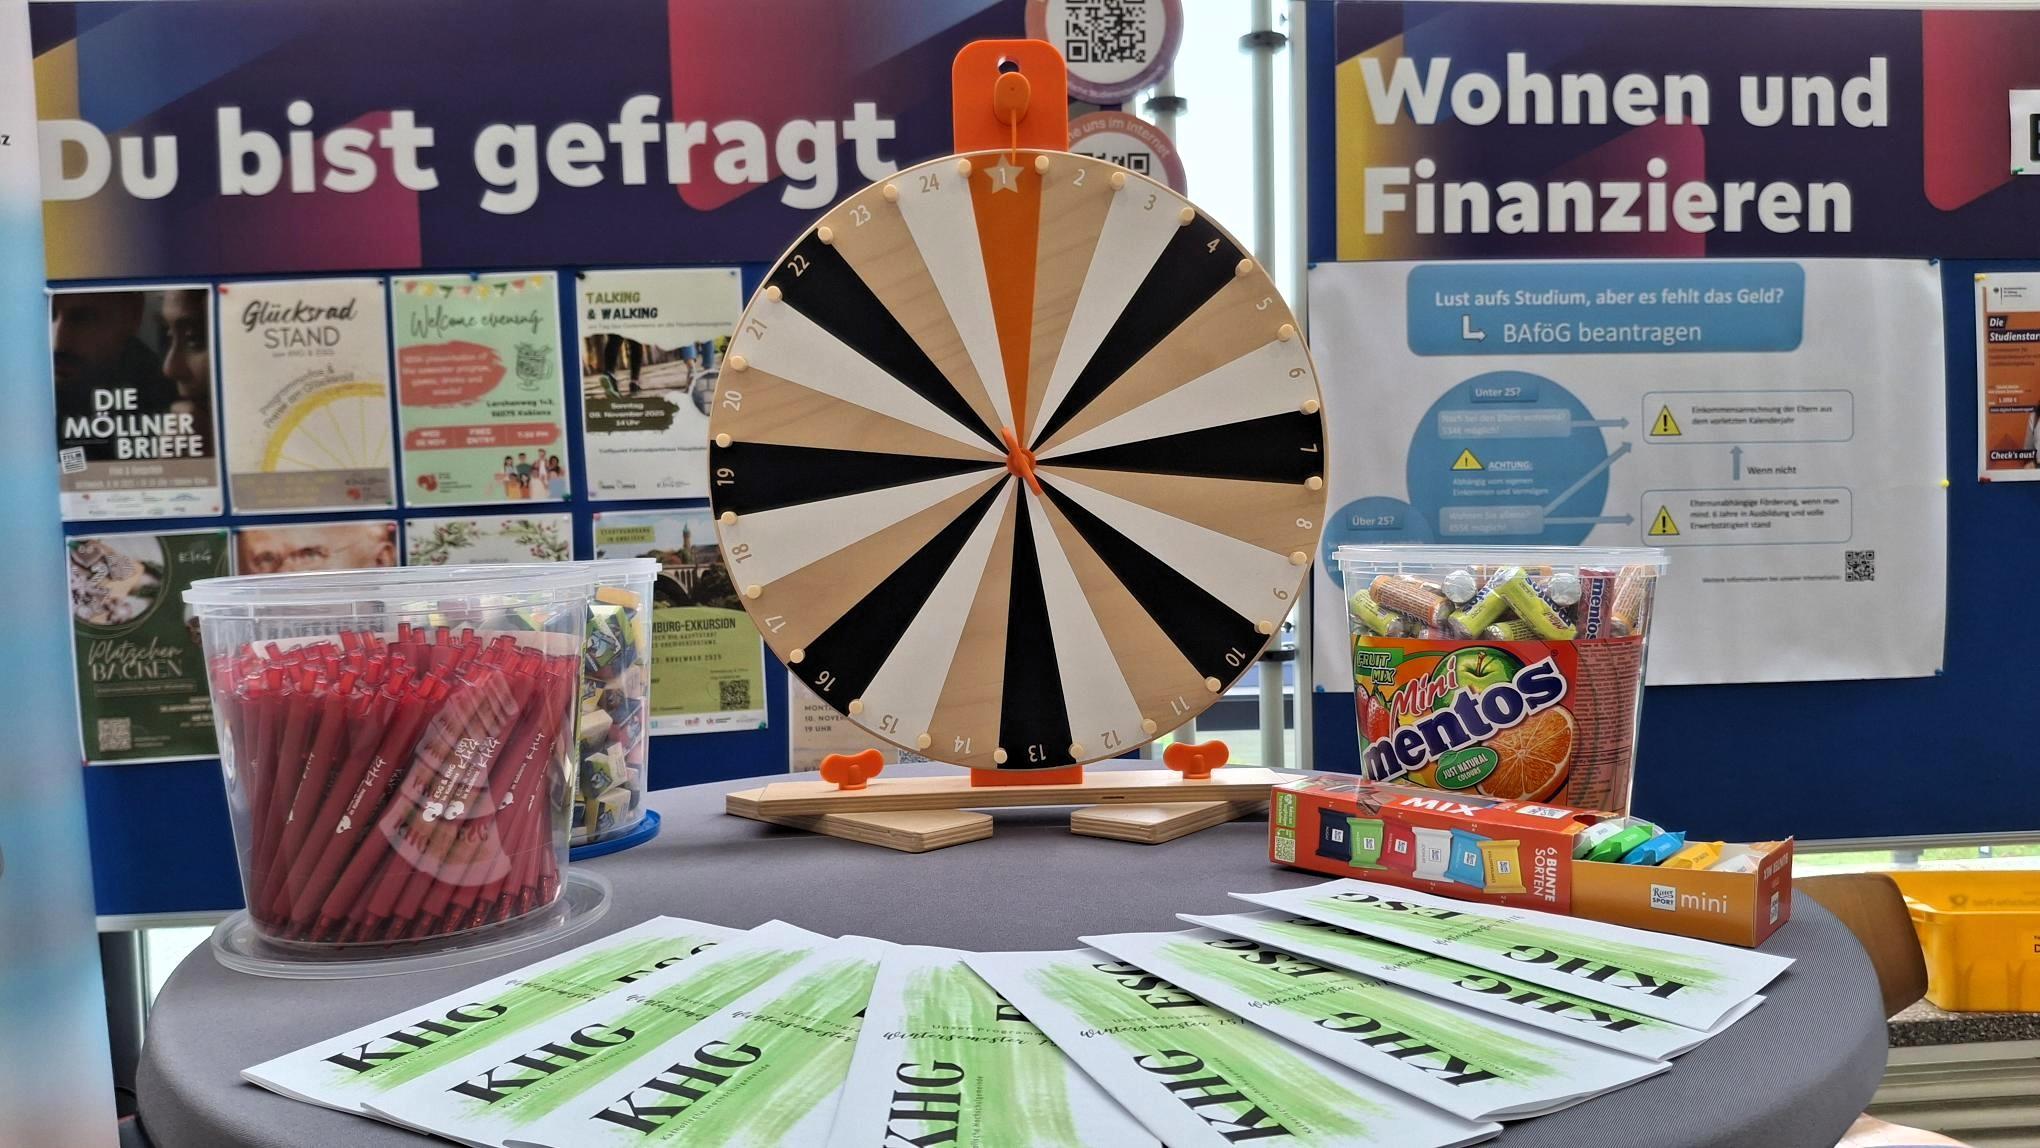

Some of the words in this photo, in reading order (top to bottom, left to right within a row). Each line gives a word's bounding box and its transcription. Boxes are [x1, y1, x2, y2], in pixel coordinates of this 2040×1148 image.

[1358, 53, 1710, 125] Wohnen
[1740, 57, 1888, 127] und
[1084, 118, 1107, 133] uns
[1109, 117, 1126, 129] im
[38, 119, 178, 201] Du
[217, 100, 440, 196] bist
[474, 94, 898, 214] gefragt
[919, 172, 940, 194] 24
[1000, 167, 1007, 185] 1
[1073, 169, 1085, 187] 2
[1144, 194, 1157, 211] 3
[1363, 158, 1853, 235] Finanzieren
[849, 204, 872, 228] 23
[1206, 238, 1220, 254] 4
[787, 254, 811, 278] 22
[585, 291, 640, 304] TALKING
[1256, 297, 1273, 311] 5
[1435, 291, 1470, 307] Lust
[1474, 290, 1510, 306] aufs
[1514, 290, 1591, 308] Studium,
[1595, 289, 1634, 305] aber
[1638, 292, 1657, 305] es
[1661, 288, 1701, 304] fehlt
[1704, 288, 1733, 304] das
[1737, 287, 1784, 304] Geld?
[242, 298, 358, 332] Glücksrad
[410, 304, 477, 339] Welcome
[481, 309, 543, 334] evening
[587, 309, 596, 320] &
[601, 307, 658, 320] WALKING
[1989, 317, 2004, 328] Die
[264, 325, 341, 349] STAND
[746, 317, 768, 341] 21
[1503, 323, 1571, 343] BAföG
[1579, 322, 1702, 345] beantragen
[1288, 366, 1306, 380] 6
[95, 388, 138, 411] DIE
[723, 390, 743, 412] 20
[1475, 388, 1502, 397] Unter
[1504, 387, 1521, 397] 25?
[611, 402, 644, 411] Sonntag
[64, 412, 195, 439] MÖLLNER
[118, 435, 203, 459] BRIEFE
[1300, 443, 1318, 454] 7
[1991, 451, 2017, 460] Check's
[2018, 450, 2036, 459] aus!
[1488, 460, 1533, 471] ACHTUNG:
[1747, 467, 1773, 475] Wenn
[1775, 466, 1797, 475] nicht
[716, 467, 735, 487] 19
[1296, 517, 1313, 530] 8
[1352, 515, 1376, 526] Über
[1378, 515, 1395, 525] 25?
[731, 543, 753, 564] 18
[1273, 587, 1289, 601] 9
[764, 614, 787, 634] 17
[1225, 646, 1247, 667] 10
[1358, 652, 1391, 668] FRUIT
[92, 660, 184, 681] BACKEN
[814, 670, 837, 692] 16
[1371, 668, 1397, 685] MIX
[1391, 656, 1458, 734] Mini
[1170, 696, 1191, 716] 11
[879, 714, 899, 735] 15
[1364, 656, 1567, 782] mentos
[954, 736, 972, 754] 14
[1100, 729, 1122, 750] 12
[1028, 744, 1048, 763] 13
[1442, 765, 1458, 780] JUST
[1458, 754, 1489, 773] NATURAL
[1457, 767, 1482, 782] COLOURS
[1401, 797, 1485, 817] MIX
[1547, 847, 1558, 855] 6
[1533, 848, 1546, 897] SORTEN
[1544, 858, 1558, 903] BUNTE
[1330, 892, 1465, 920] ESG
[1652, 897, 1674, 905] SPORT
[1681, 892, 1728, 914] mini
[1204, 937, 1341, 979] ESG
[1501, 944, 1688, 1000] KHG
[1247, 985, 1354, 1009] Wintersemester
[1451, 974, 1646, 1033] KHG
[732, 1010, 857, 1043] Wintersemester
[1080, 1020, 1210, 1038] Wintersemester
[322, 1002, 509, 1075] KHG
[883, 1031, 1029, 1045] Wintersemester
[1313, 1012, 1503, 1087] KHG
[446, 1023, 636, 1105] KHG
[589, 1040, 762, 1136] KHG
[1133, 1049, 1296, 1144] KHG
[882, 1060, 965, 1148] KHG
[661, 1110, 706, 1141] Katholische
